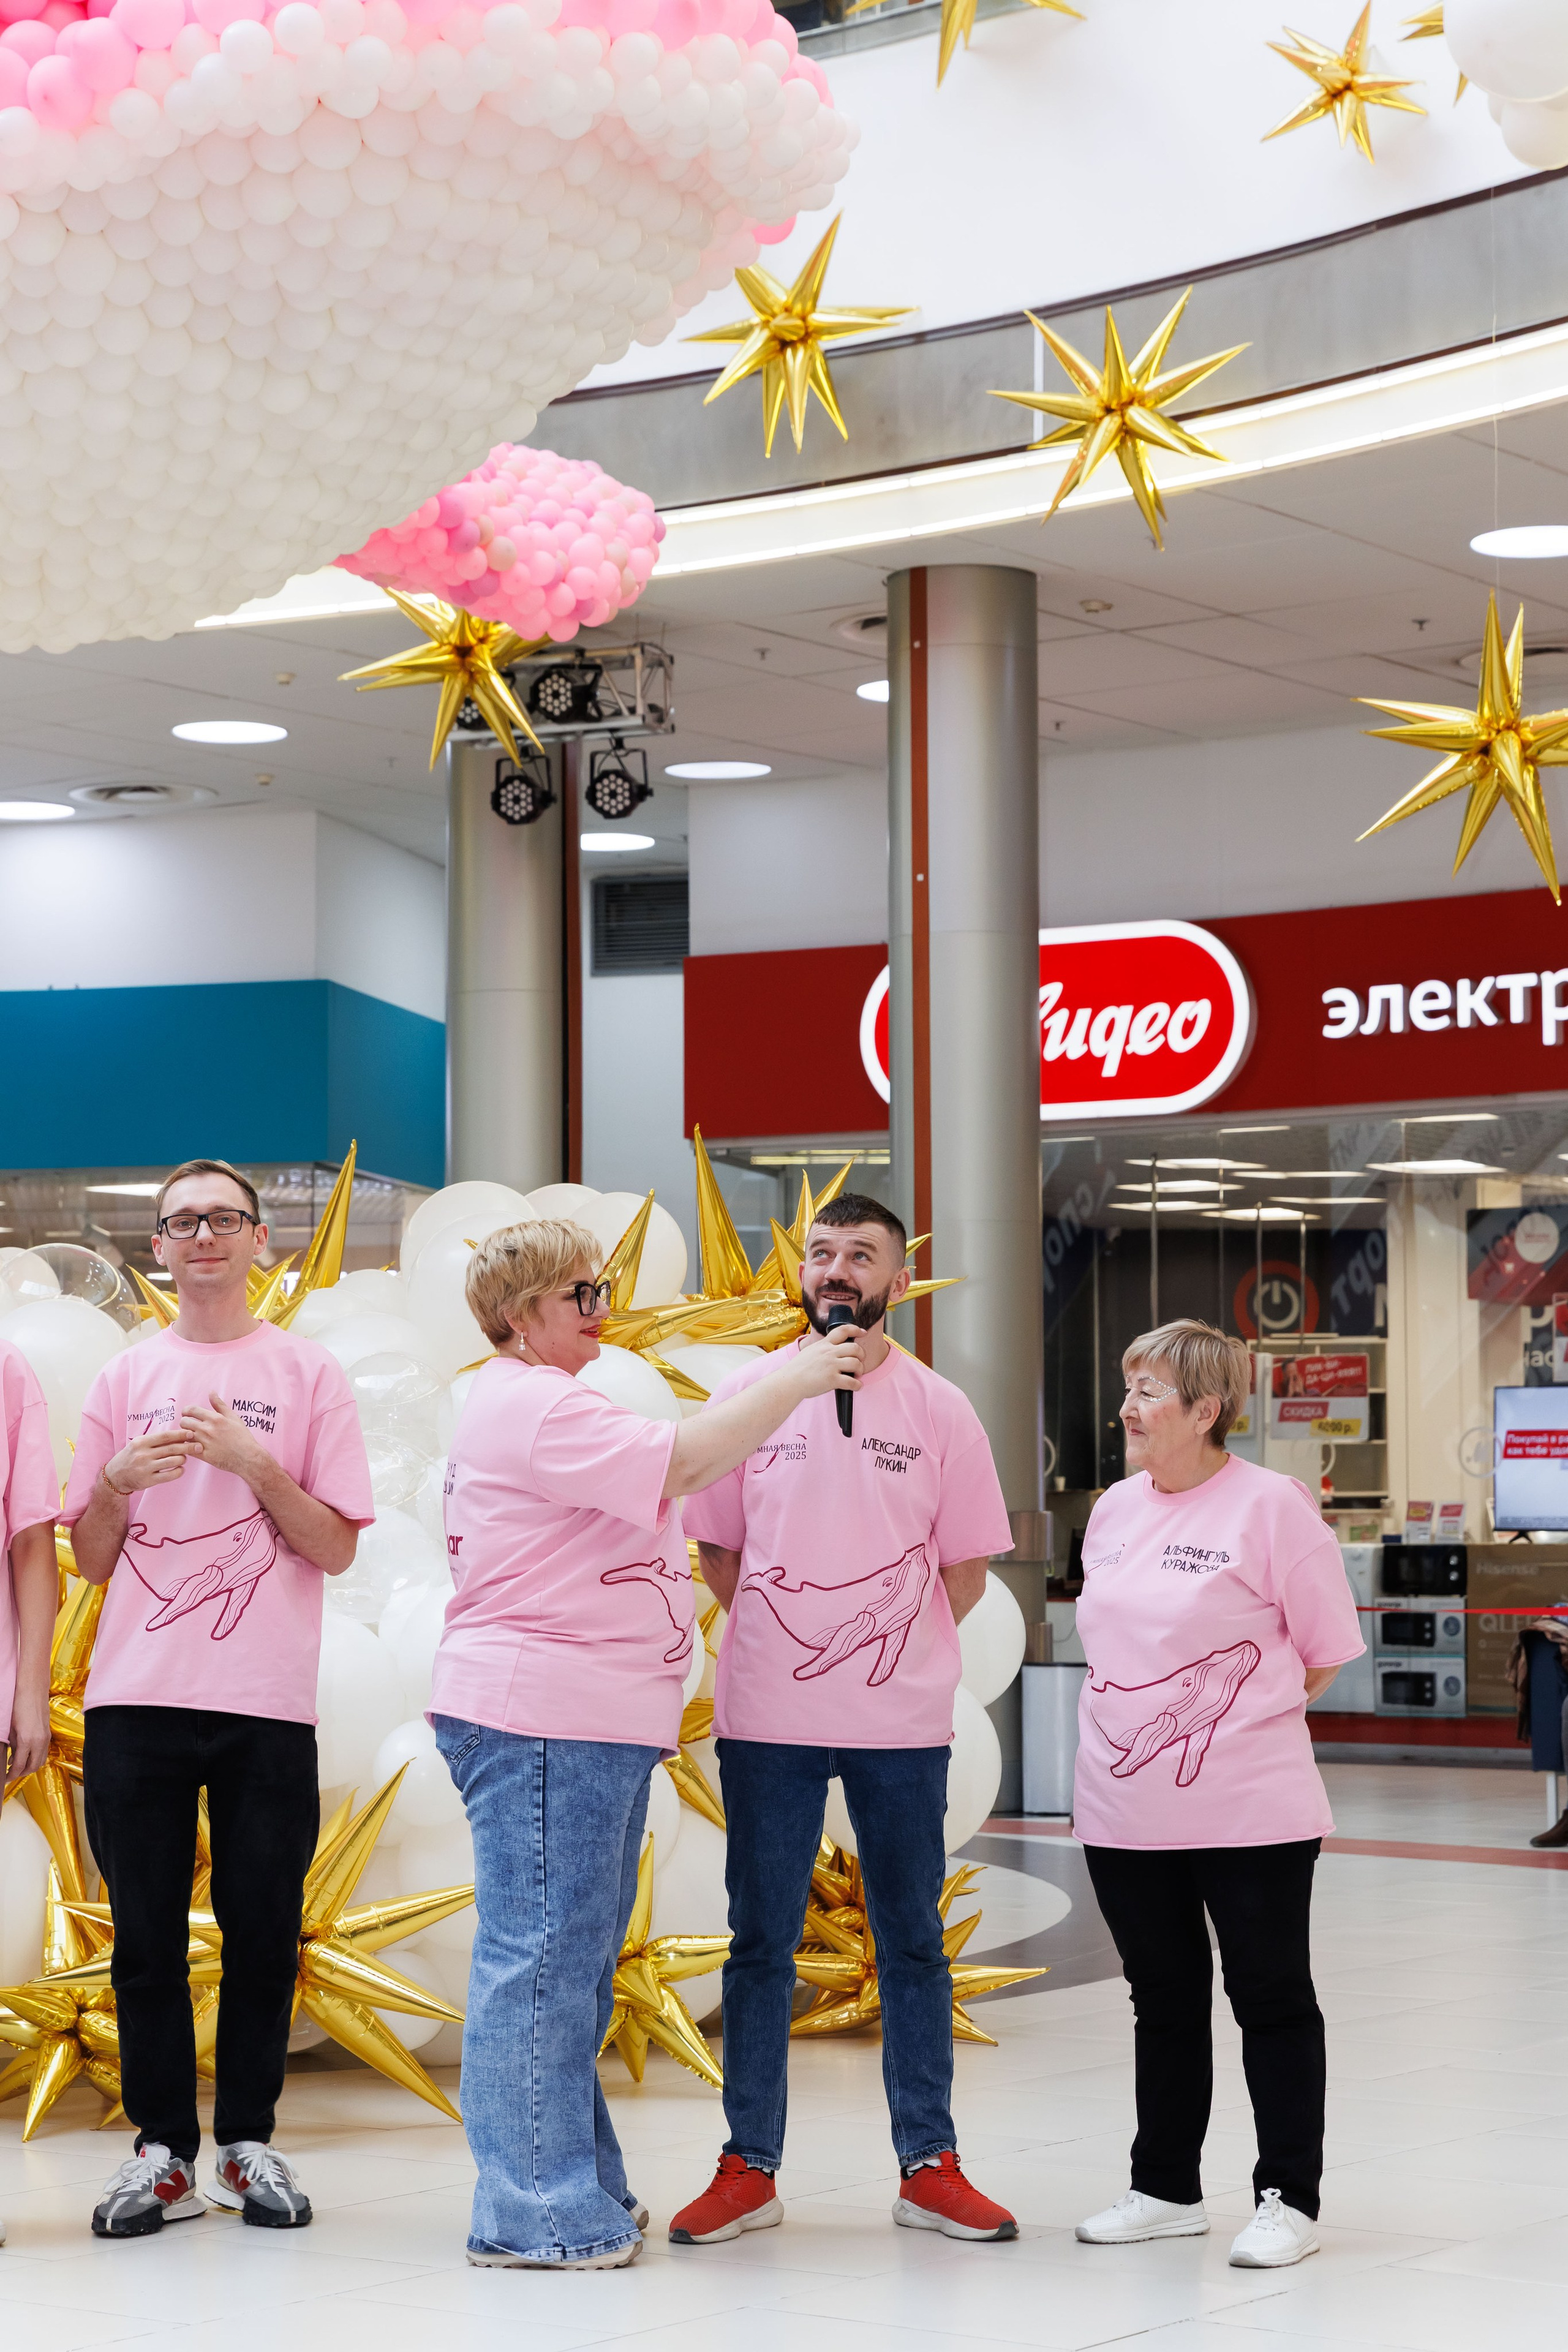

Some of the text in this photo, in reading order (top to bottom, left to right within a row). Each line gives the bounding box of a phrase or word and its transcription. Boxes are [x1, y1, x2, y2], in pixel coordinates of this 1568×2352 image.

[1322, 968, 1568, 1046] электр
[127, 1405, 175, 1422] УМНАЯ ВЕСНА
[232, 1399, 276, 1418] МАКСИМ
[158, 1412, 175, 1425] 2025
[240, 1415, 275, 1434] ЗЬМИН
[753, 1443, 807, 1454] МНАЯ ВЕСНА
[785, 1451, 807, 1461] 2025
[861, 1438, 921, 1460] АЛЕКСАНДР
[875, 1456, 907, 1474] ЛУКИН
[447, 1534, 464, 1556] ar
[1163, 1545, 1230, 1563] АЛЬФИНГУЛЬ
[1161, 1559, 1220, 1574] КУРАЖОВА
